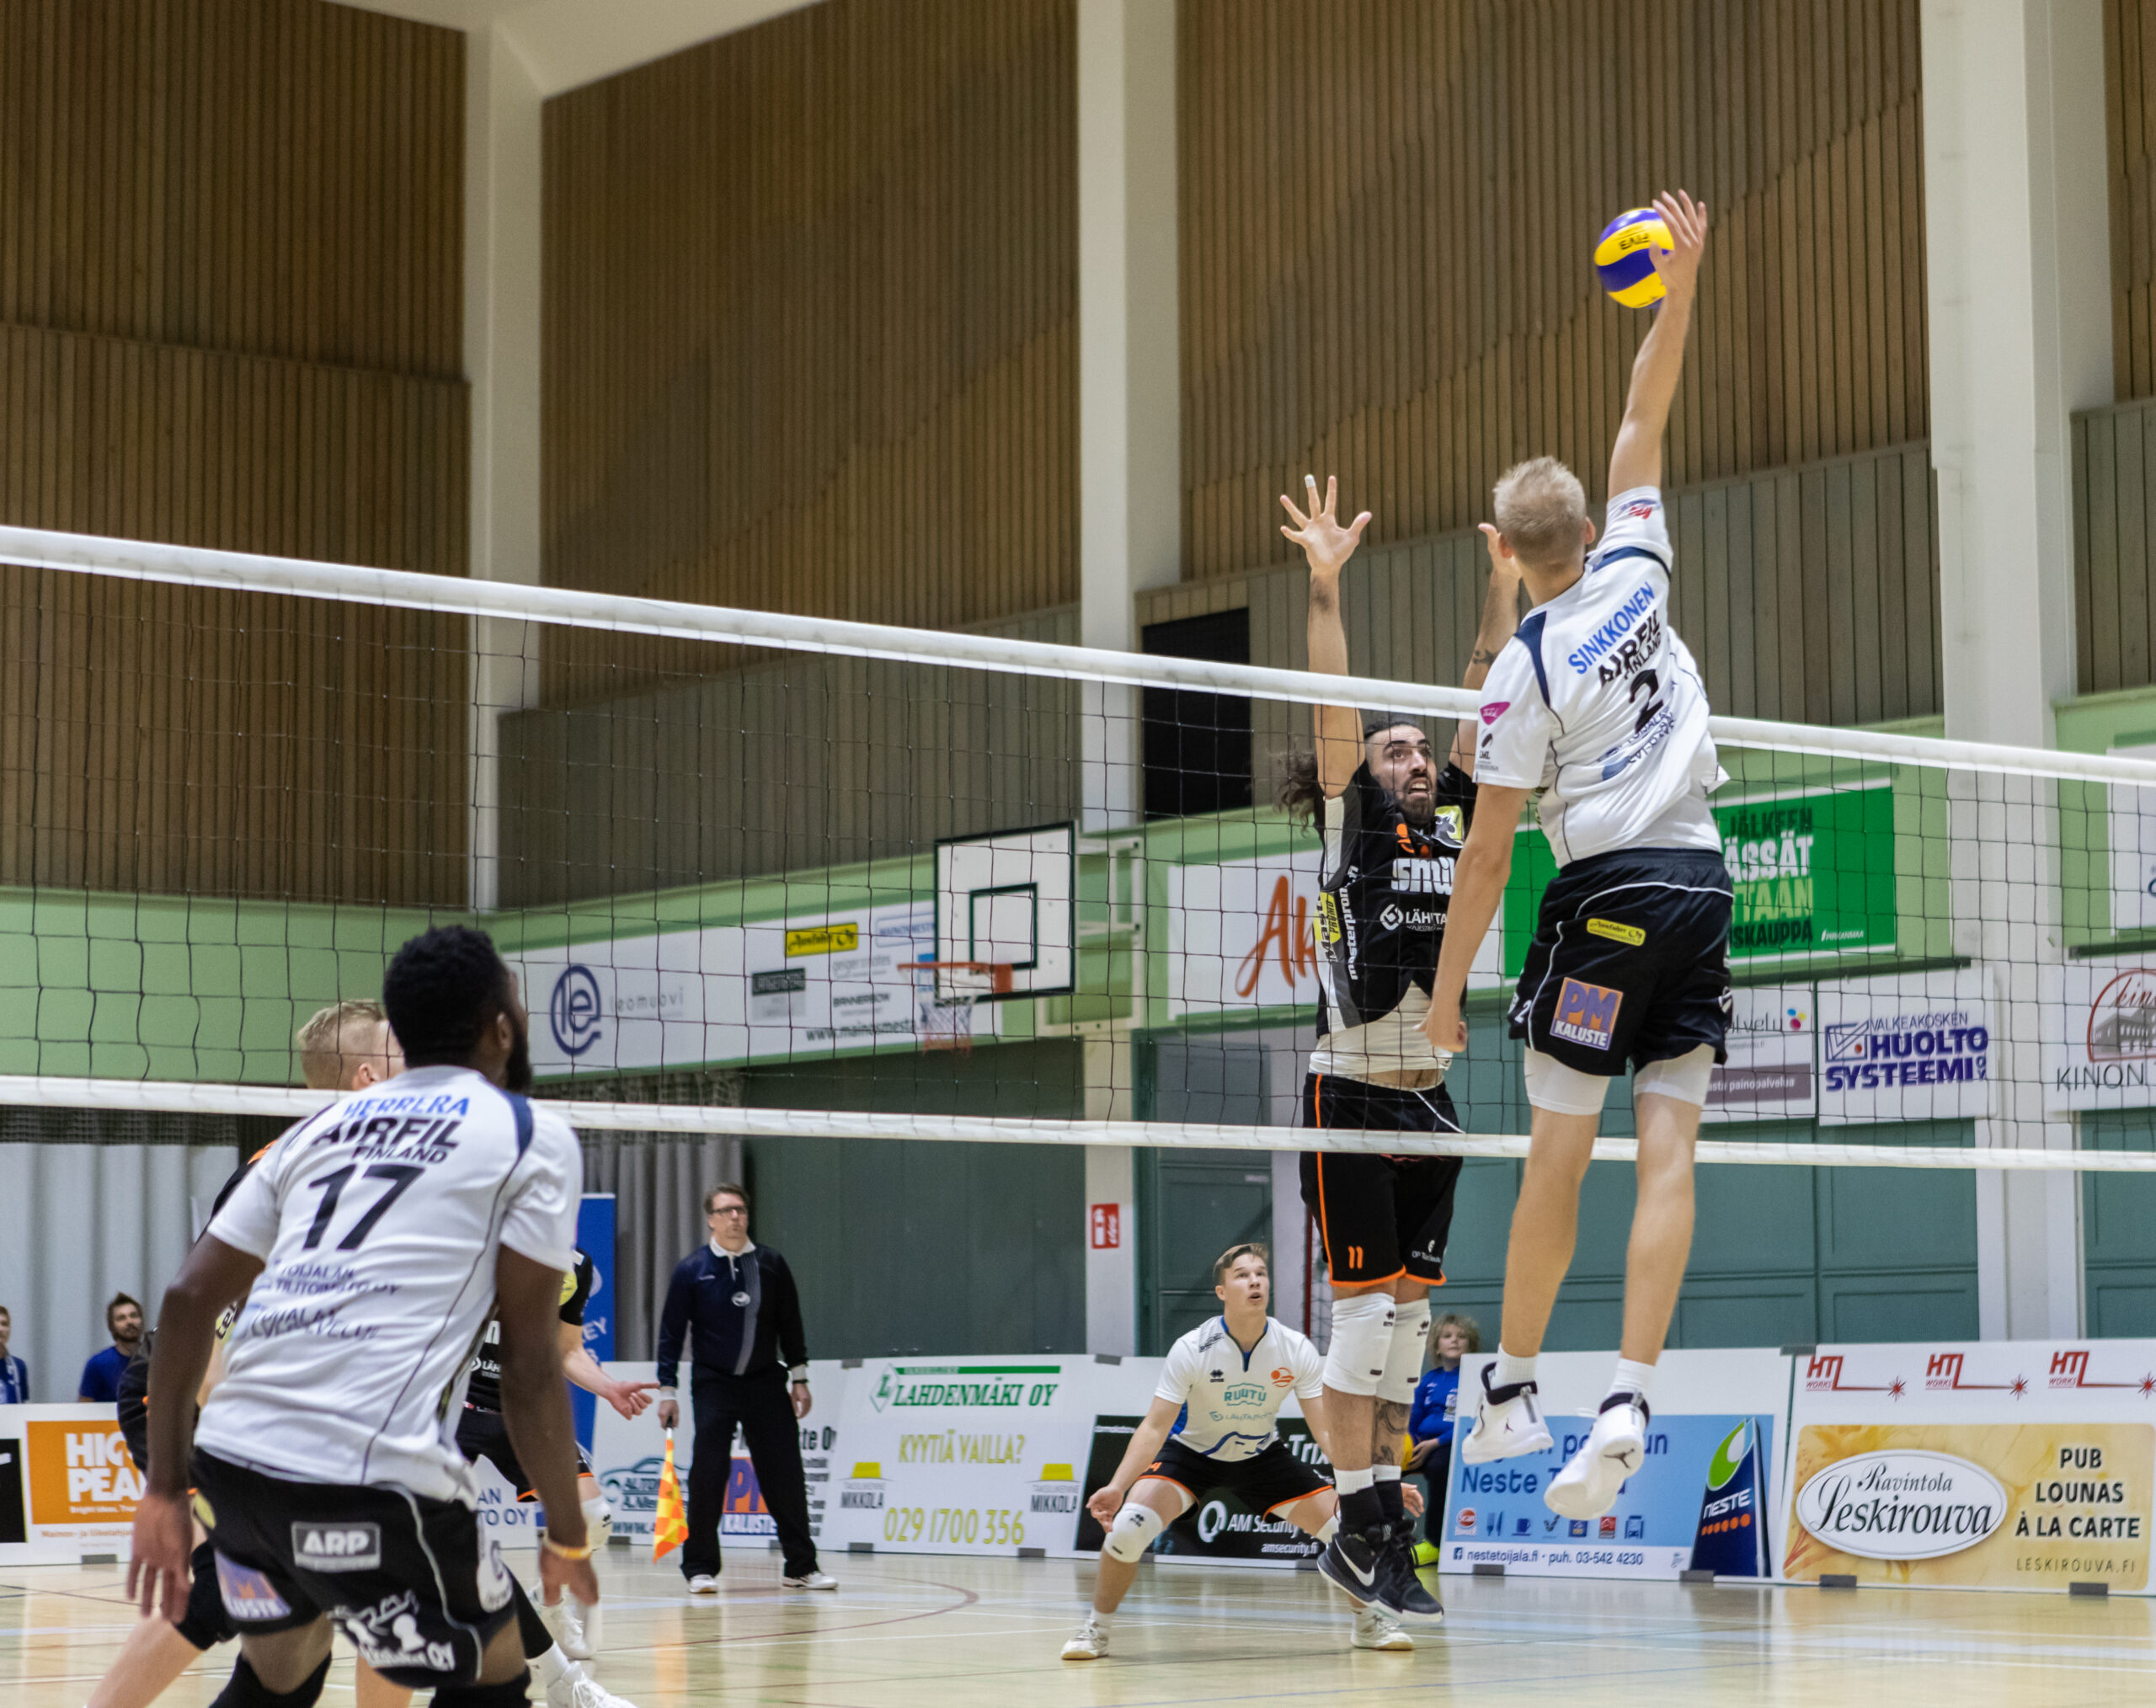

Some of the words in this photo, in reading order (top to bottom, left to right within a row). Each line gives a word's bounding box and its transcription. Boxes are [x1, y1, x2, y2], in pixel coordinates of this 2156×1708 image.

[1568, 581, 1655, 675] SINKKONEN
[1629, 669, 1663, 735] 2
[1725, 830, 1813, 883] ÄSSÄT
[1560, 981, 1619, 1033] PM
[1554, 1020, 1609, 1048] KALUSTE
[1870, 1011, 1968, 1033] VALKEAKOSKEN
[1870, 1027, 1988, 1059] HUOLTO
[1826, 1057, 1974, 1092] SYSTEEMI
[2057, 1063, 2144, 1092] KINON
[312, 1118, 462, 1149] AIRFIL
[351, 1145, 447, 1163] FINLAND
[303, 1164, 426, 1252] 17
[893, 1377, 1024, 1406] LAHDENMÄKI
[1028, 1384, 1059, 1406] OY
[66, 1432, 125, 1466] HIG
[898, 1429, 955, 1463] KYYTIÄ
[959, 1434, 1025, 1464] VAILLA?
[2059, 1449, 2102, 1469] PUB
[1460, 1466, 1538, 1494] Neste
[1857, 1462, 1953, 1492] Ravintola
[840, 1492, 883, 1508] MIKKOLA
[1031, 1495, 1078, 1513] MIKKOLA
[1703, 1487, 1753, 1519] NESTE
[1809, 1474, 1993, 1536] Leskirouva
[2035, 1482, 2124, 1503] LOUNAS
[504, 1508, 529, 1525] OY
[884, 1507, 924, 1541] 029
[929, 1508, 978, 1544] 1700
[983, 1509, 1024, 1545] 356
[1227, 1514, 1253, 1531] AM
[2015, 1512, 2029, 1537] À
[2036, 1518, 2062, 1537] LA
[2069, 1518, 2140, 1538] CARTE
[303, 1530, 370, 1555] ARP
[1261, 1542, 1318, 1557] amsecurity.fi
[1467, 1550, 1539, 1565] nestetoijala.fi
[1549, 1551, 1572, 1566] puh.
[1575, 1551, 1613, 1565] 03-542
[1616, 1551, 1644, 1566] 4230
[2015, 1557, 2137, 1573] LESKIROUVA.FI
